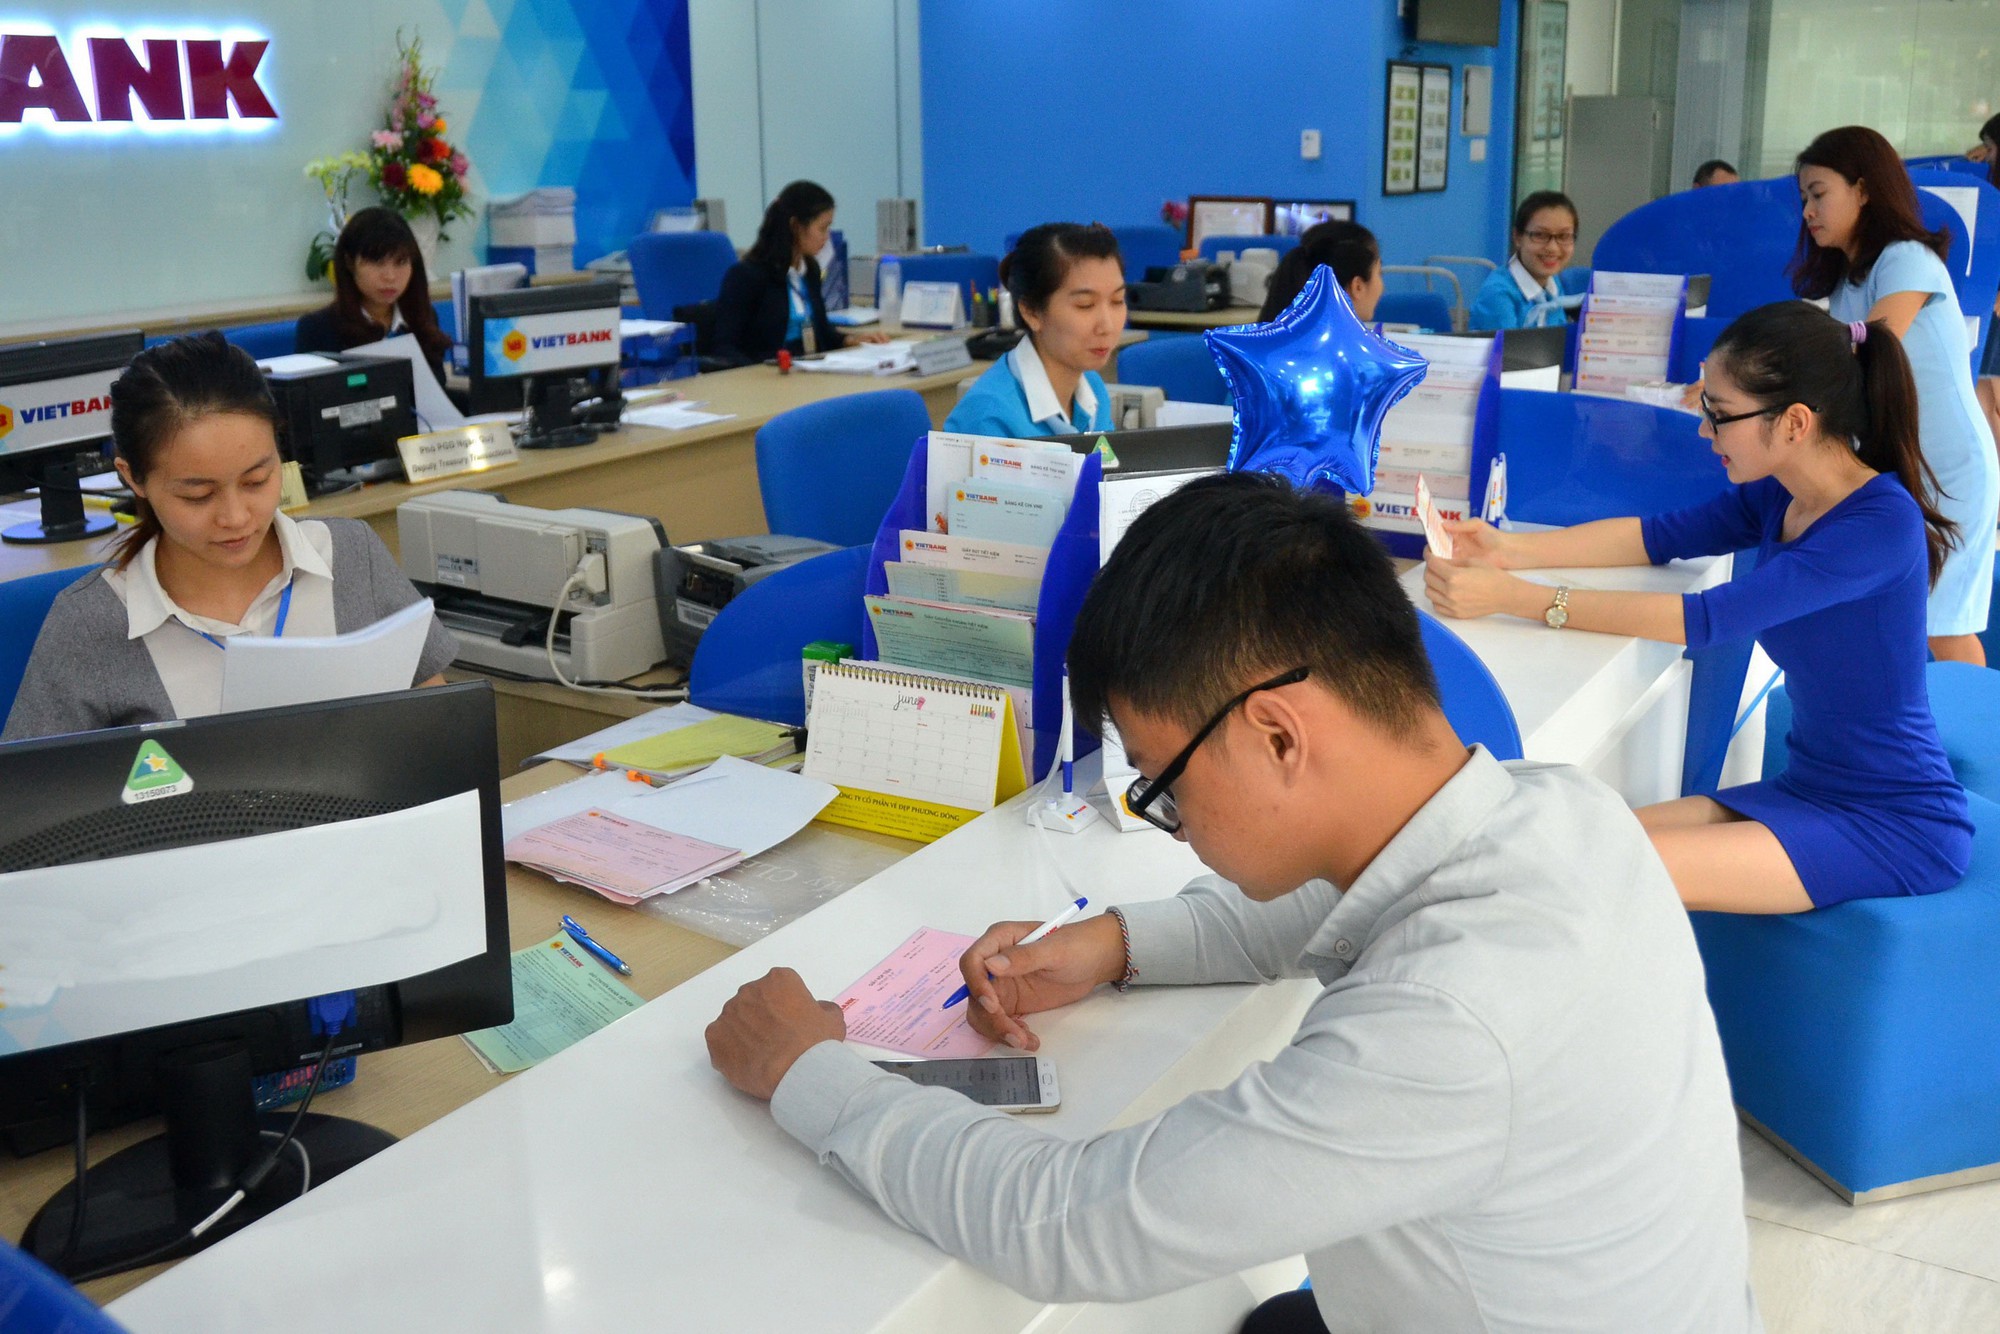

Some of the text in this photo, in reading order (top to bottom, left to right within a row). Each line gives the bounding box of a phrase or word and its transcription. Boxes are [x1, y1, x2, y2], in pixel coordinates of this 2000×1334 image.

[0, 34, 279, 123] ANK
[531, 328, 612, 349] VIETBANK
[412, 463, 437, 473] Deputy
[439, 457, 468, 467] Treasury
[990, 457, 1022, 467] VIETBANK
[966, 493, 998, 502] VIETBANK
[1374, 502, 1462, 521] VIETBNK
[915, 542, 947, 551] VIETBANK
[882, 607, 913, 617] VIETBANK
[893, 690, 919, 711] june
[134, 785, 177, 800] 13150073
[560, 947, 584, 968] VIETBANK
